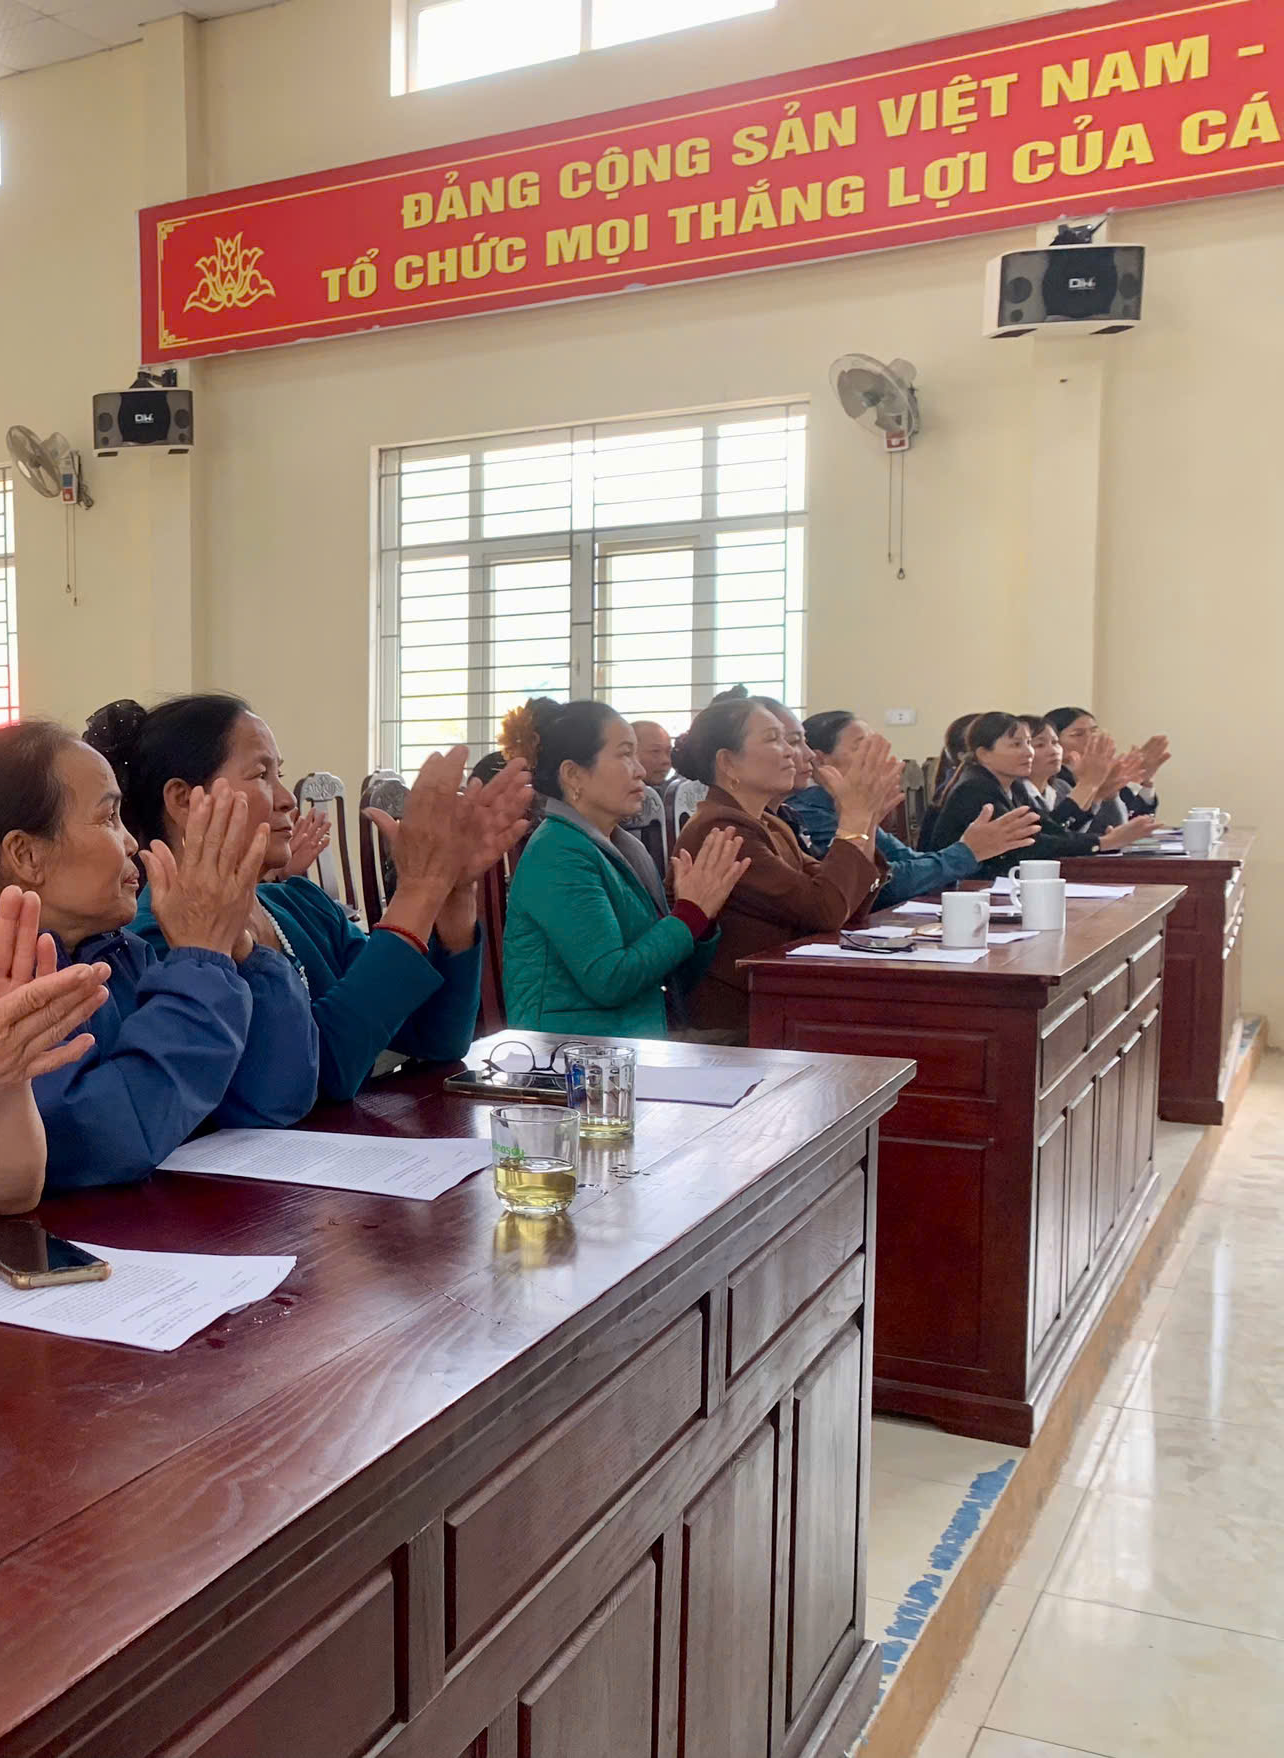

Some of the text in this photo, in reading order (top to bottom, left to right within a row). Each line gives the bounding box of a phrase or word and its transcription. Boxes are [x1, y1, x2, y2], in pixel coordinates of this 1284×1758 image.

[321, 90, 1282, 303] TỔ CHỨC MỌI THẮNG LỢI CỦA CÁ
[401, 172, 539, 229] ĐẢNG
[558, 137, 709, 201] CỘNG
[731, 101, 857, 167] SẢN
[878, 73, 1018, 138] VIỆT
[1041, 34, 1209, 108] NAM
